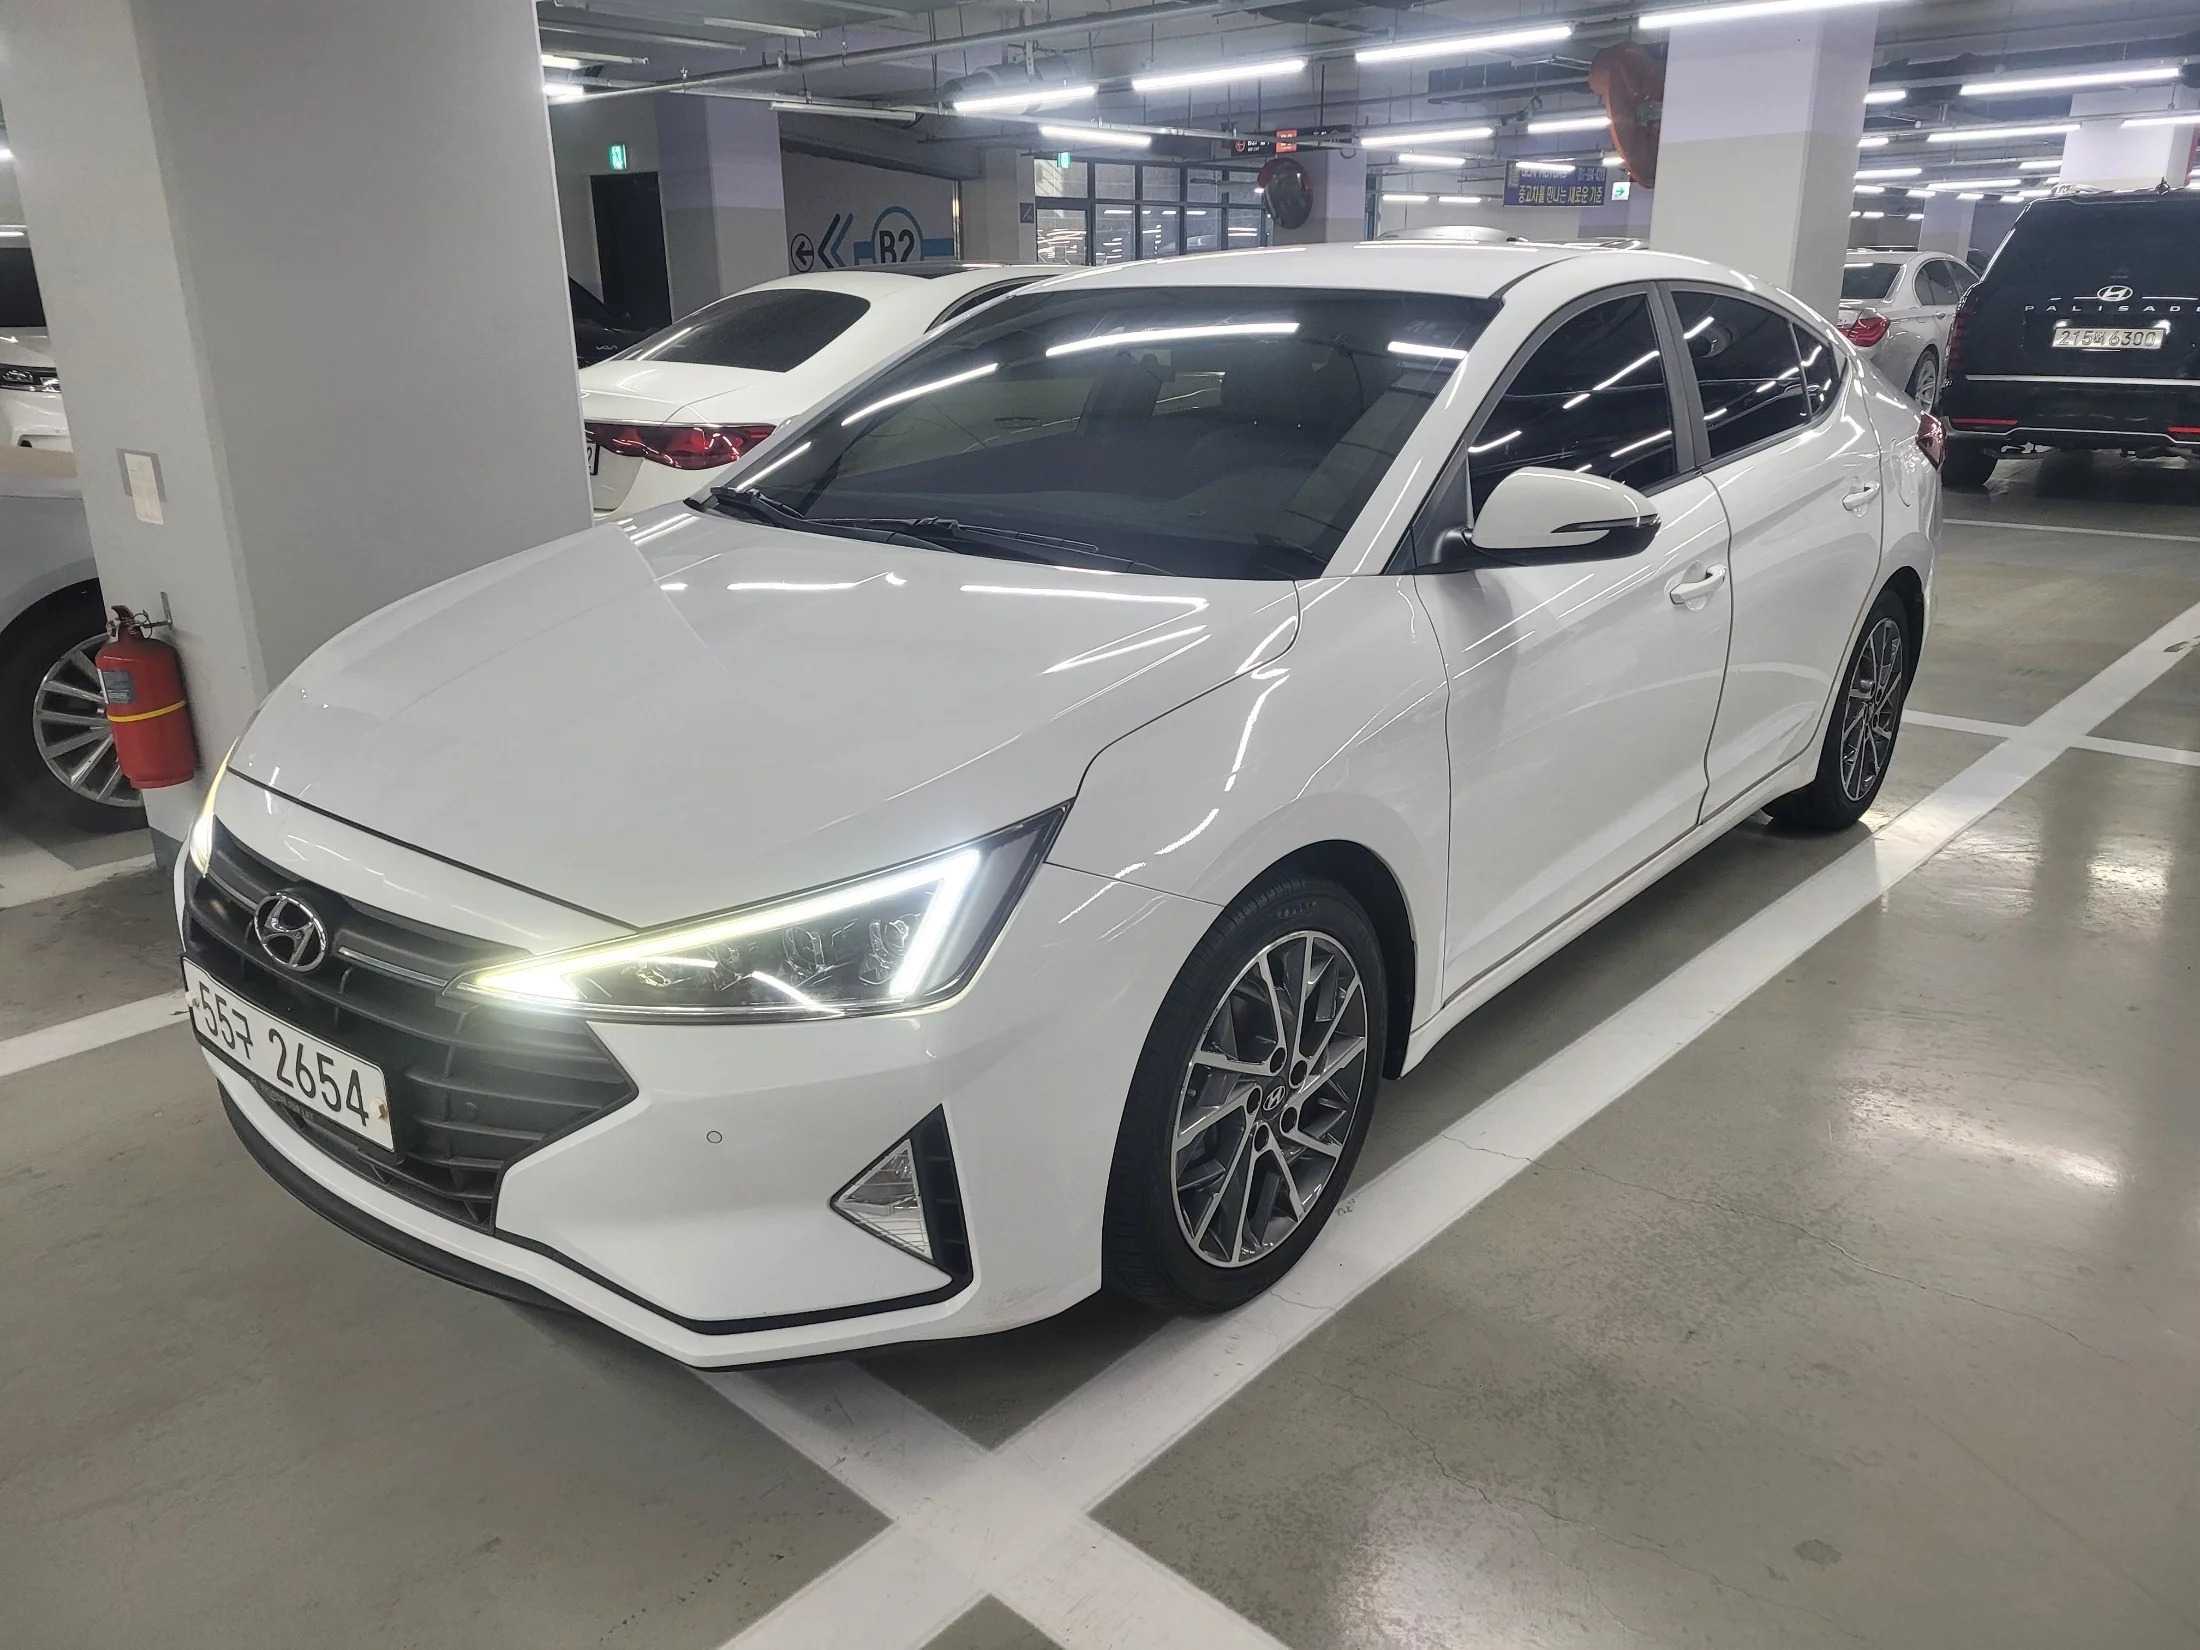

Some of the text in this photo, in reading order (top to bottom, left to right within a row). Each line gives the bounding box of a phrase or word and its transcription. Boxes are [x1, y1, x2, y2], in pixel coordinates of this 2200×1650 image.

[1518, 185, 1603, 203] 중고차를 만나는 새로운 기준
[879, 229, 915, 263] B2
[199, 981, 254, 1060] 55구
[268, 1028, 369, 1127] 2654
